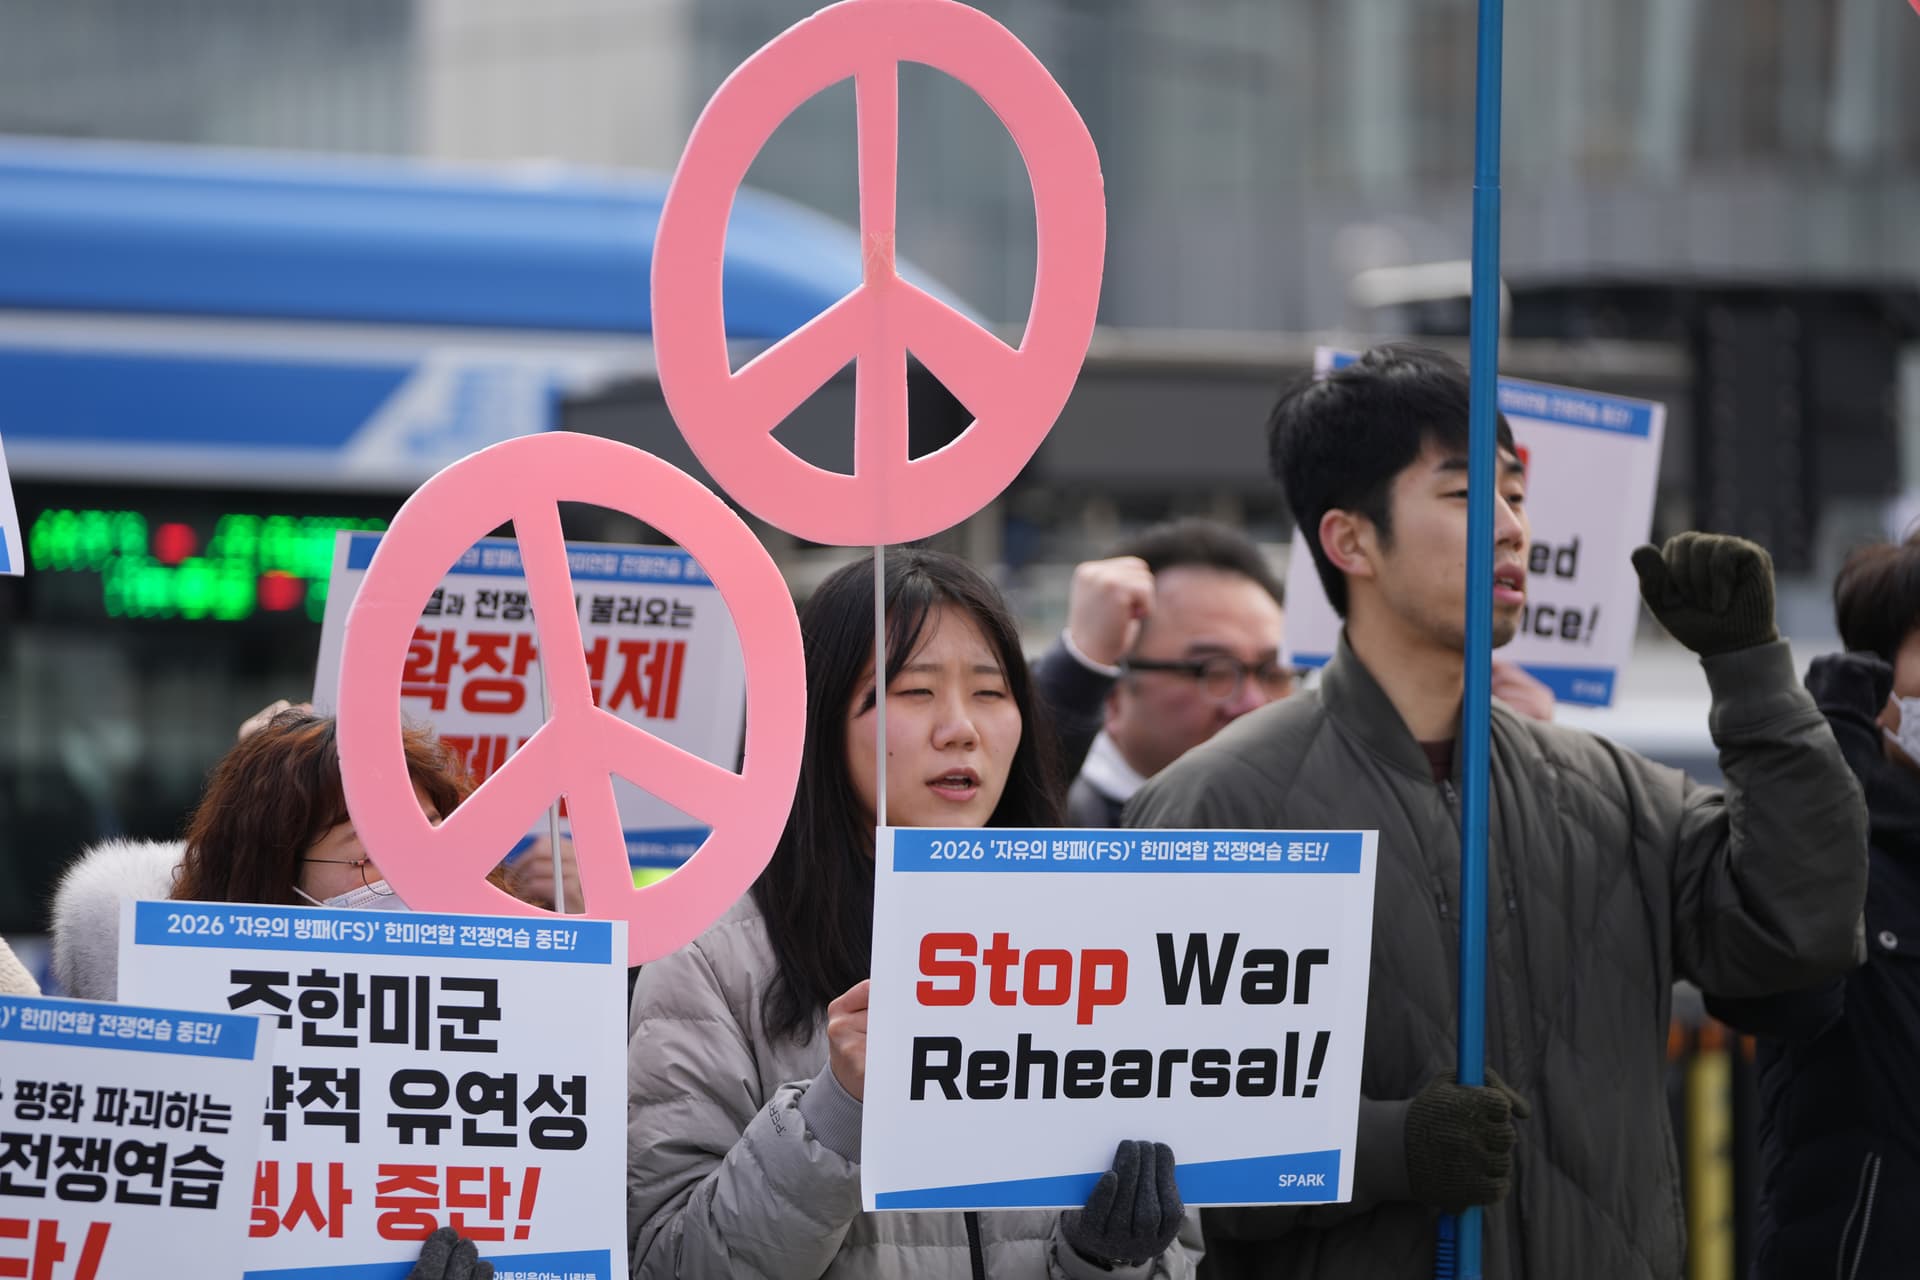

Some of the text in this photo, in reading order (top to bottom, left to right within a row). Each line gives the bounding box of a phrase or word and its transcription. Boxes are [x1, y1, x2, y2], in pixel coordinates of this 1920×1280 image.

[589, 593, 695, 629] 불러오는
[930, 839, 1329, 862] 2026 '자유의 방패(FS)' 한미연합 전쟁연습 중단!
[167, 913, 577, 950] 2026 '자유의 방패(FS)' 한미연합 전쟁연습 중단!
[916, 932, 1329, 1025] Stop War
[20, 1006, 96, 1035] 한미연합
[98, 1013, 173, 1041] 전쟁연습
[176, 1020, 222, 1045] 중단!
[227, 968, 501, 1053] 주한미군
[910, 1031, 1331, 1100] Rehearsal!
[14, 1080, 232, 1134] 평화 파괴하는
[387, 1068, 588, 1150] 유연성
[0, 1131, 225, 1209] 전쟁연습
[1278, 1173, 1326, 1187] SPARK
[375, 1163, 541, 1241] 중단!
